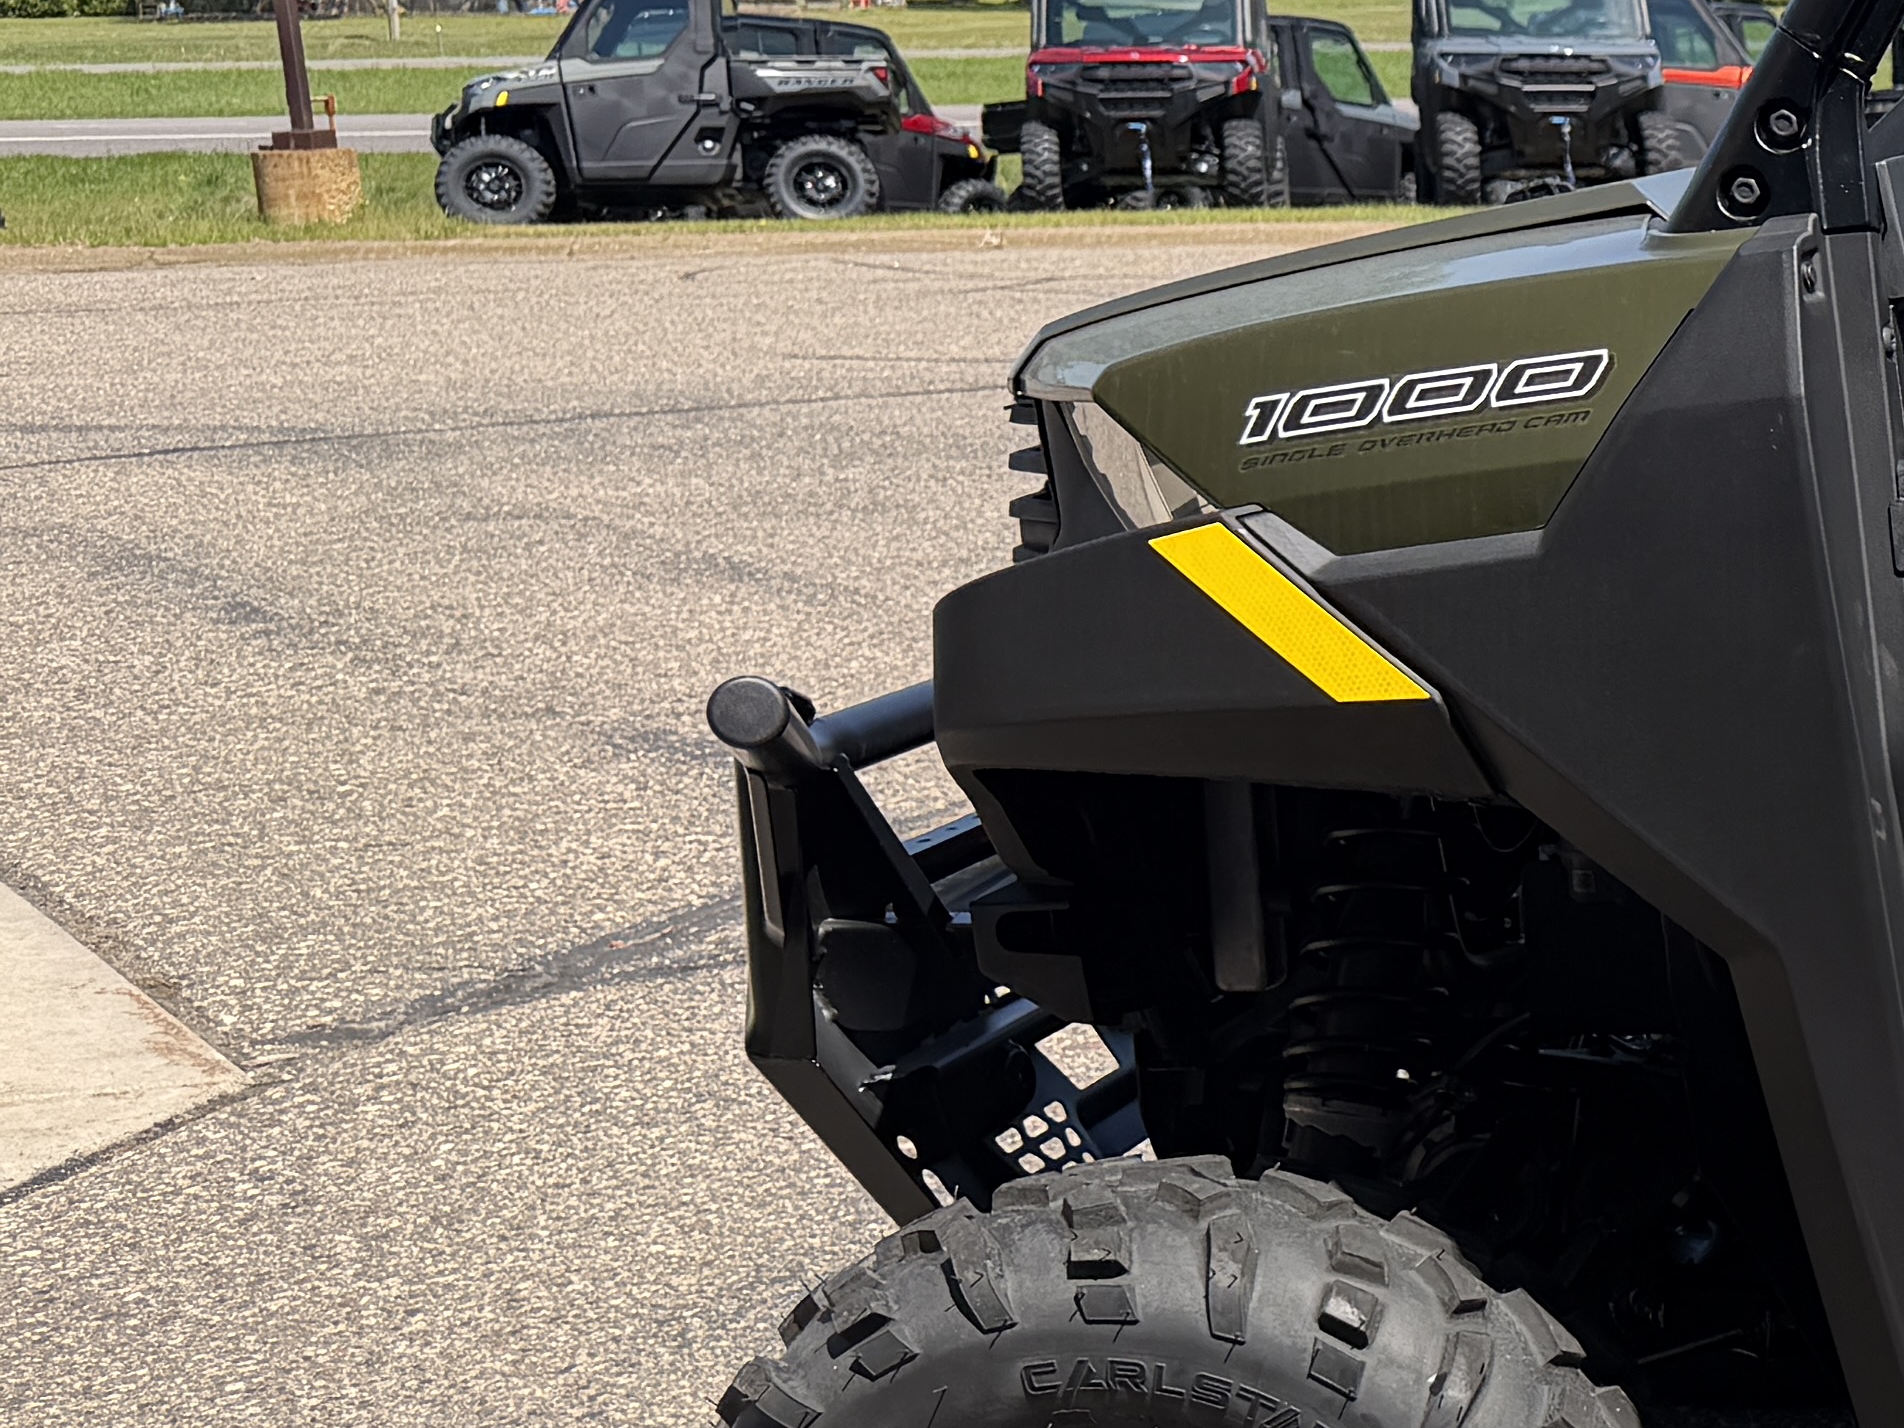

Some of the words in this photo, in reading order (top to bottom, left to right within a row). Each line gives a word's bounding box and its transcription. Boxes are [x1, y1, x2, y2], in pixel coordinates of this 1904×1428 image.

[1239, 348, 1609, 445] 1000
[1241, 442, 1347, 471] SINGLE
[1358, 420, 1515, 454] OVERHEAD
[1522, 409, 1591, 431] CAM
